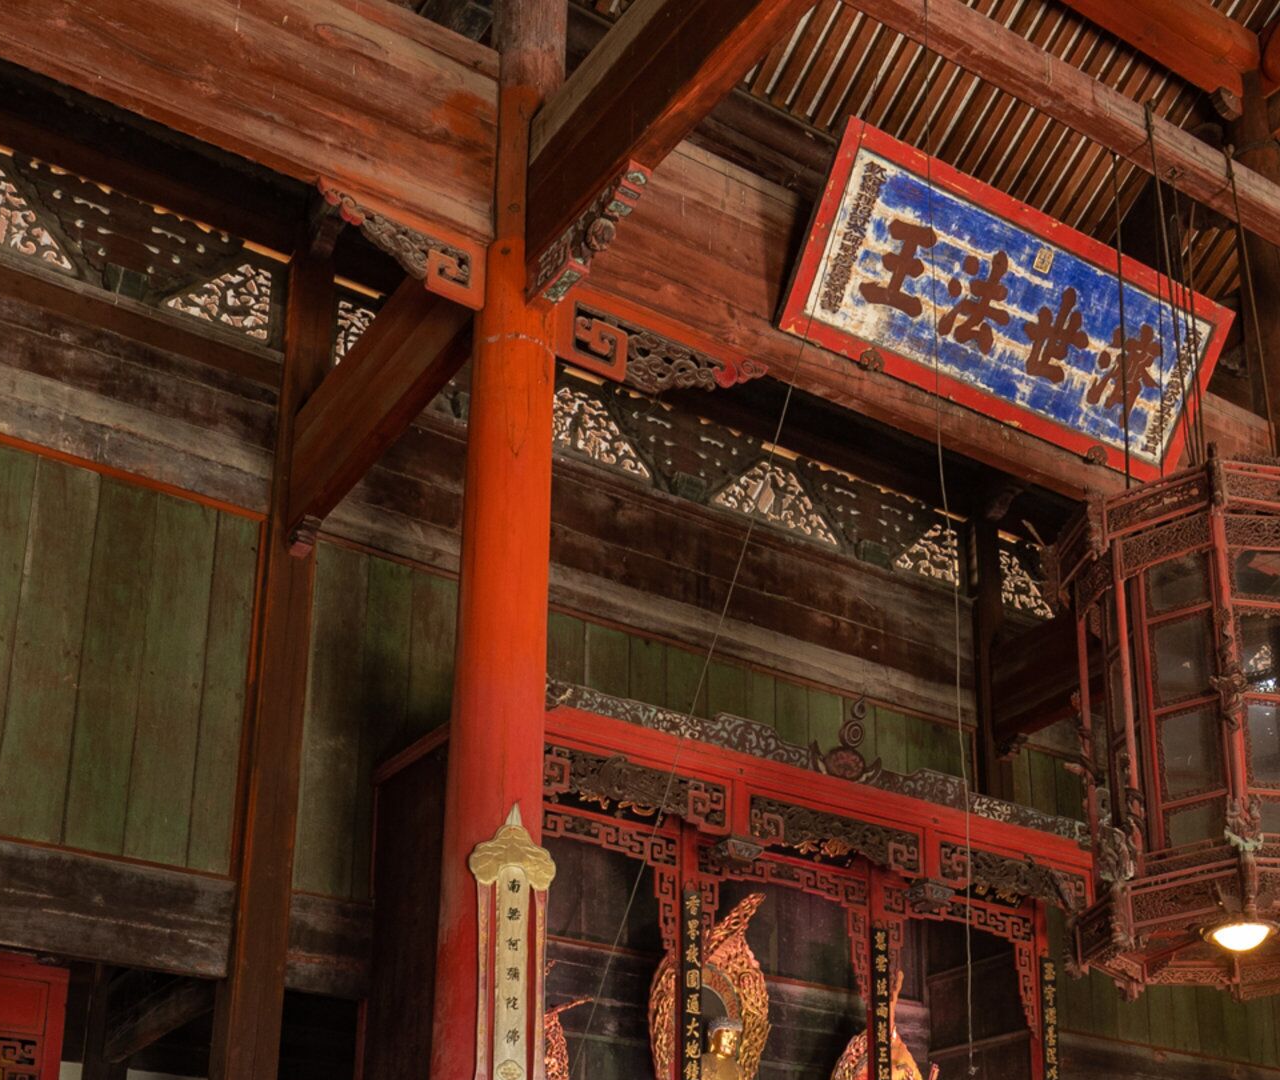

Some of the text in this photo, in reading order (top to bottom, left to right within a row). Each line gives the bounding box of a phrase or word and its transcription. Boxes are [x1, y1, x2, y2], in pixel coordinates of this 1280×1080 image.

[859, 218, 1162, 428] 濟世法王
[505, 879, 521, 1045] 南無阿彌陀佛
